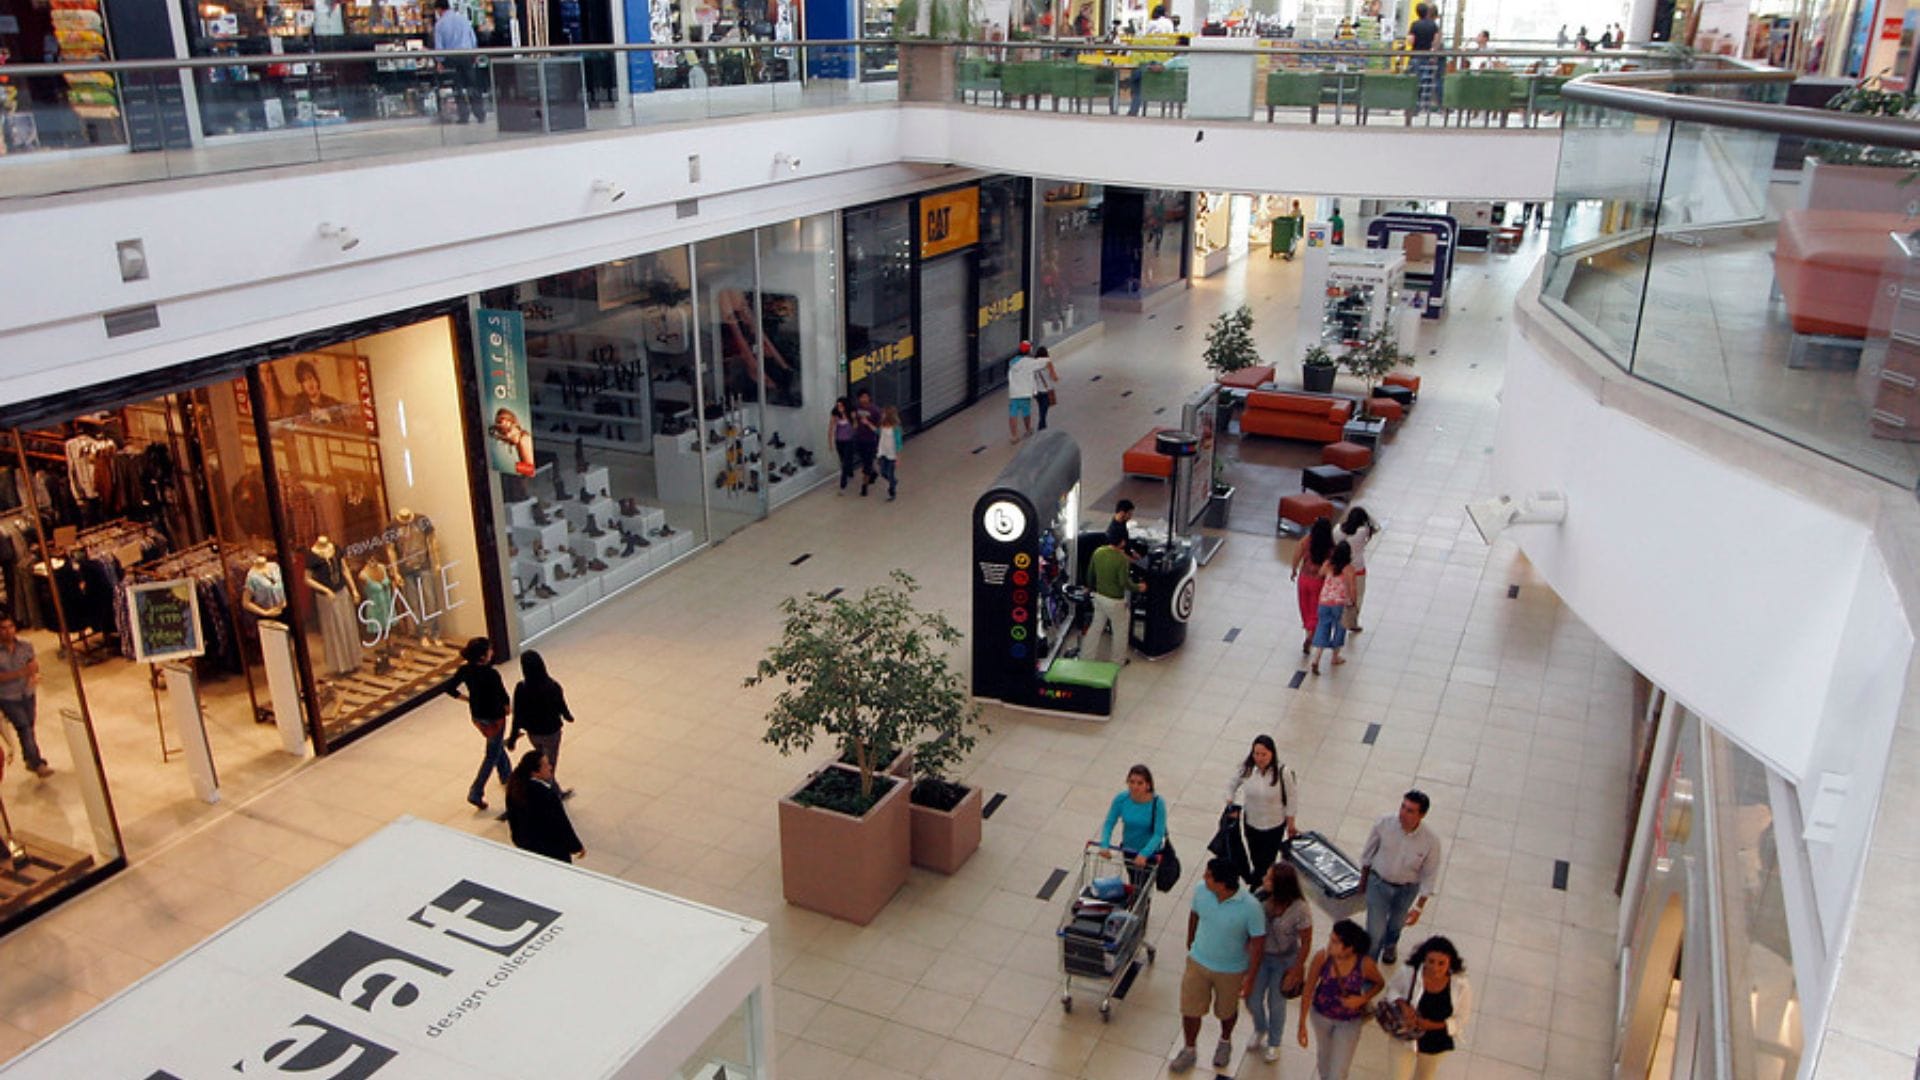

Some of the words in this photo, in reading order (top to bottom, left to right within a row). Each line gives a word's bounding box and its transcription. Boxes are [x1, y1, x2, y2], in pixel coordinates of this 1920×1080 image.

[928, 206, 952, 242] CAT
[863, 342, 900, 375] SALE
[358, 560, 465, 647] SALE
[425, 988, 488, 1039] design
[485, 924, 565, 989] collection
